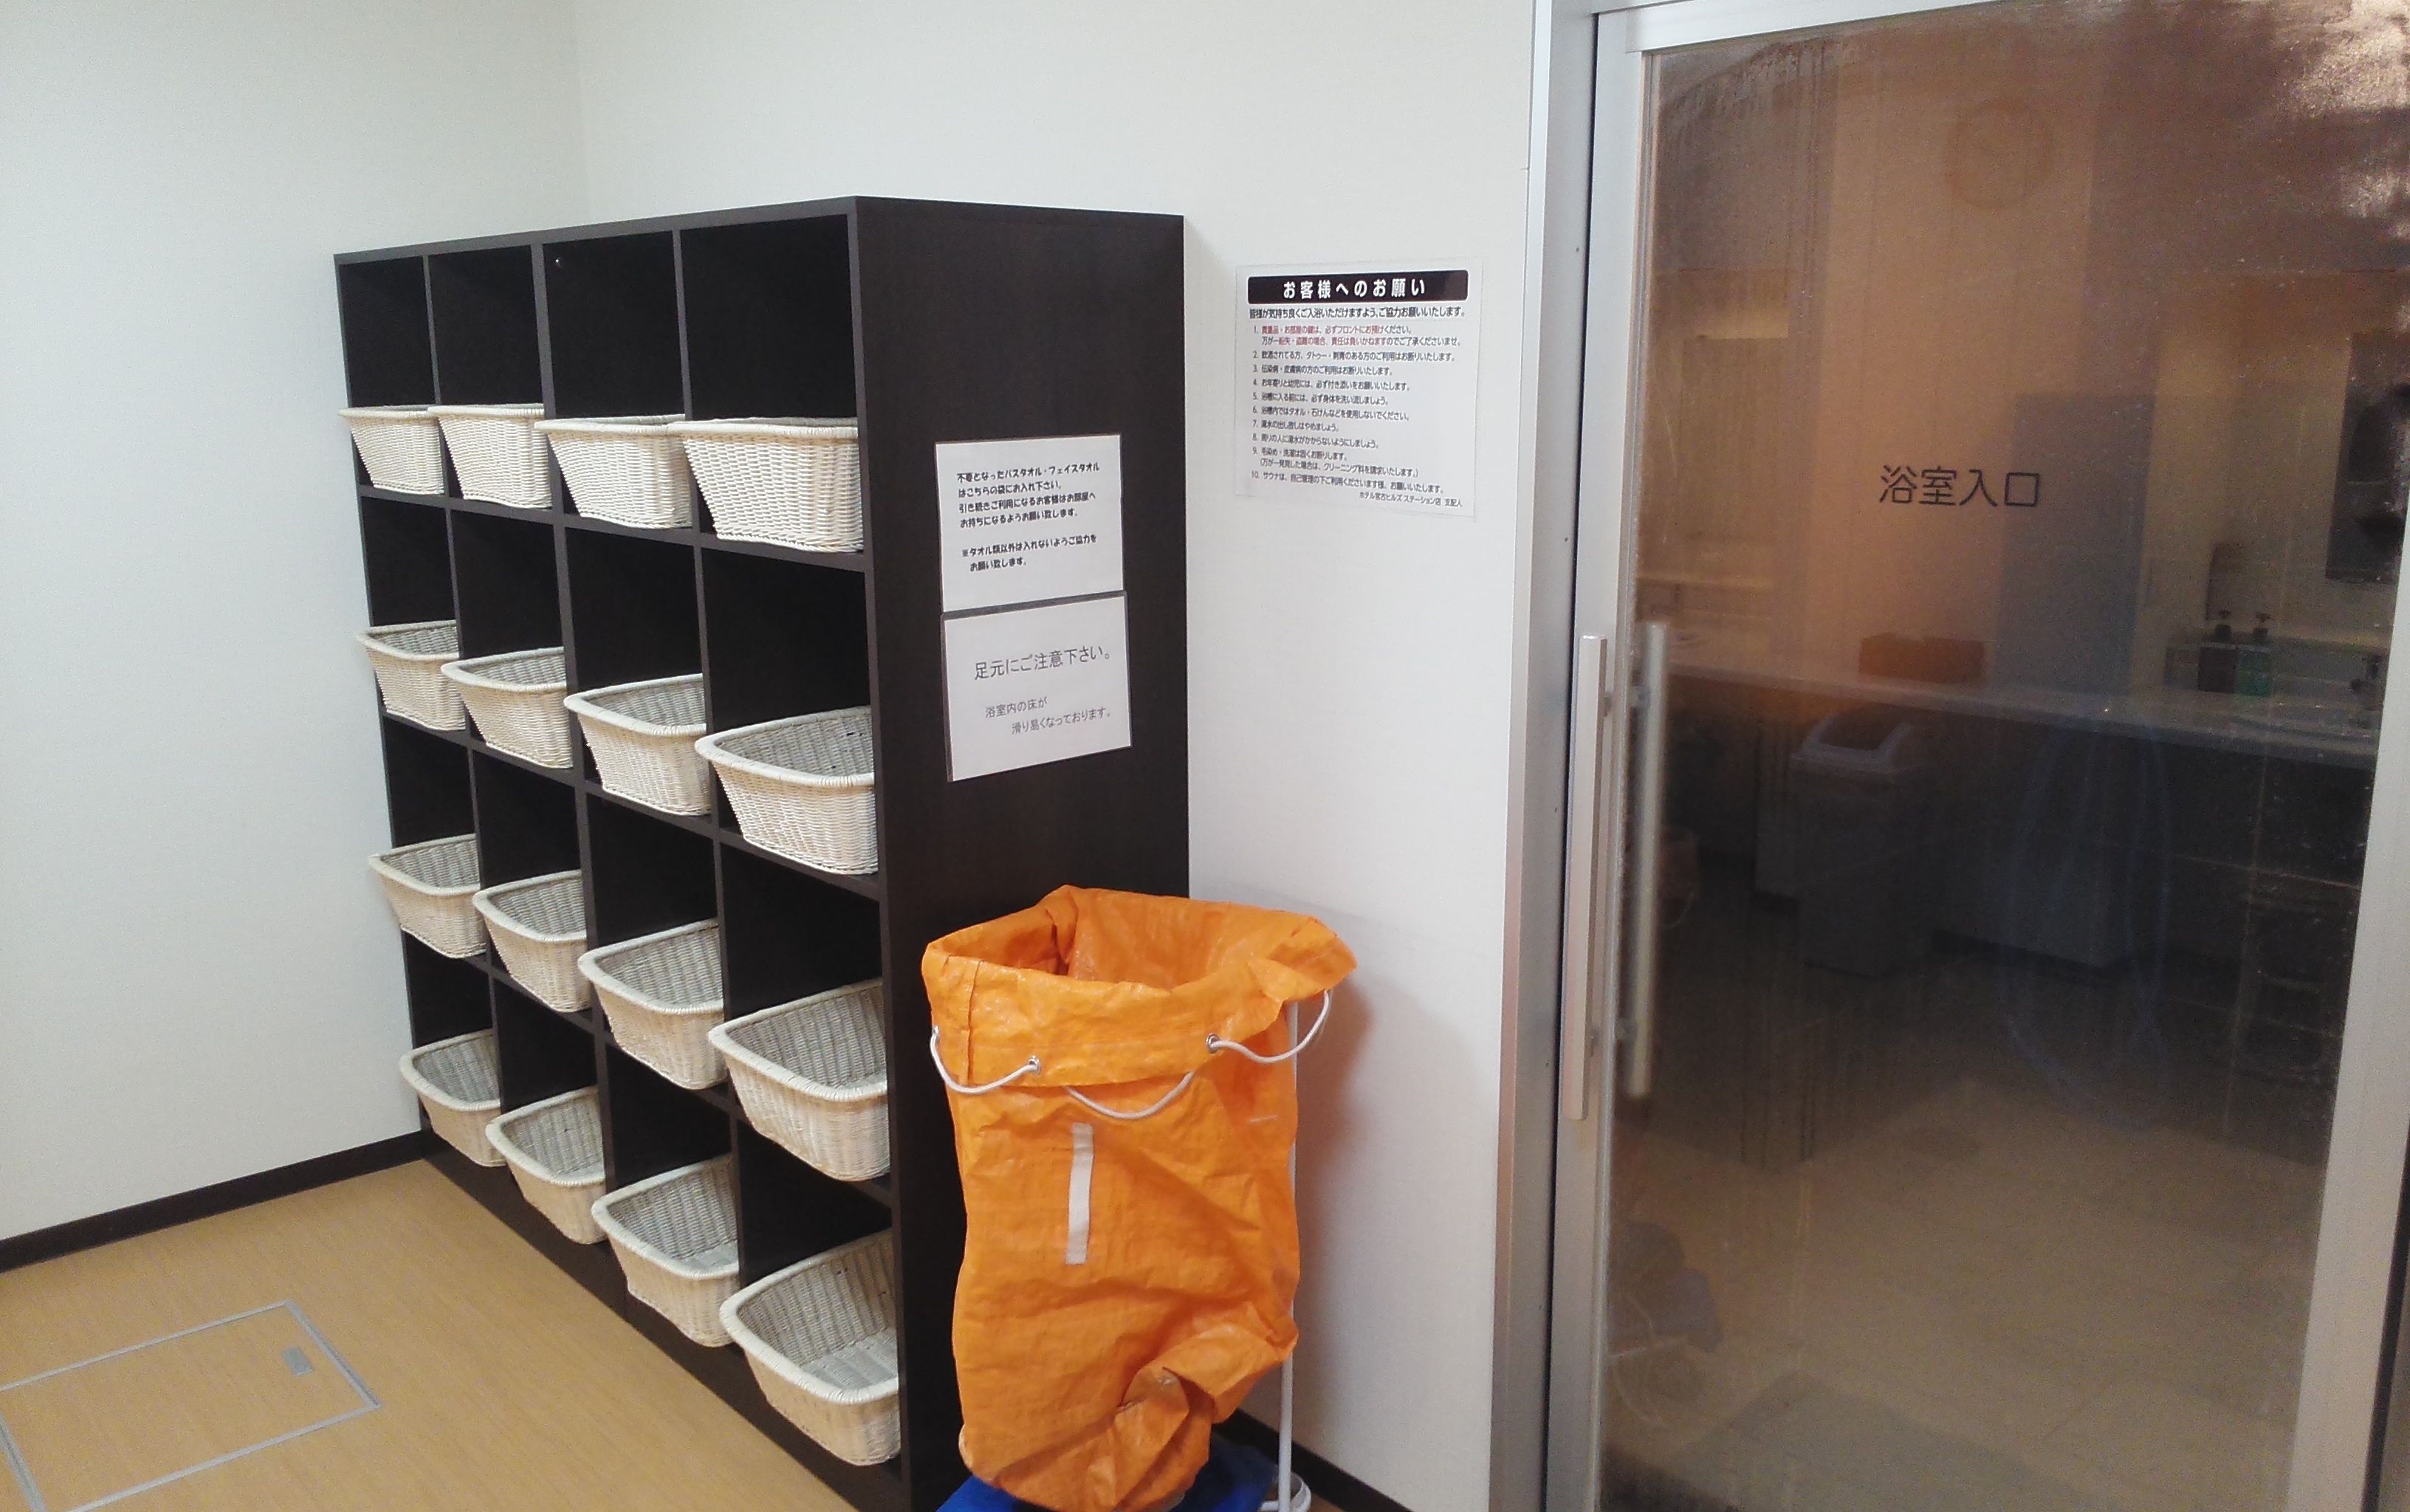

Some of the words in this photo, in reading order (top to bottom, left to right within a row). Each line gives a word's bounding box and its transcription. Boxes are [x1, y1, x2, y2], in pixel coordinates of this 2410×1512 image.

[1283, 278, 1426, 299] お客様へのお願い
[957, 462, 1100, 483] 不要となったバスタオル・フェイスタオル
[958, 480, 1062, 498] はこちらの袋にお入れ下さい。
[1879, 464, 2040, 508] 浴室入口
[959, 492, 1096, 513] 引き続きご利用になるお客様はお部屋へ
[960, 509, 1077, 528] お持ちになるようお願い致します。
[969, 557, 1027, 571] お願い致します。
[975, 645, 1110, 681] 足元にご注意下さい。
[985, 696, 1048, 718] 浴室内の床が
[1012, 707, 1111, 735] 滑り易くなっております。
